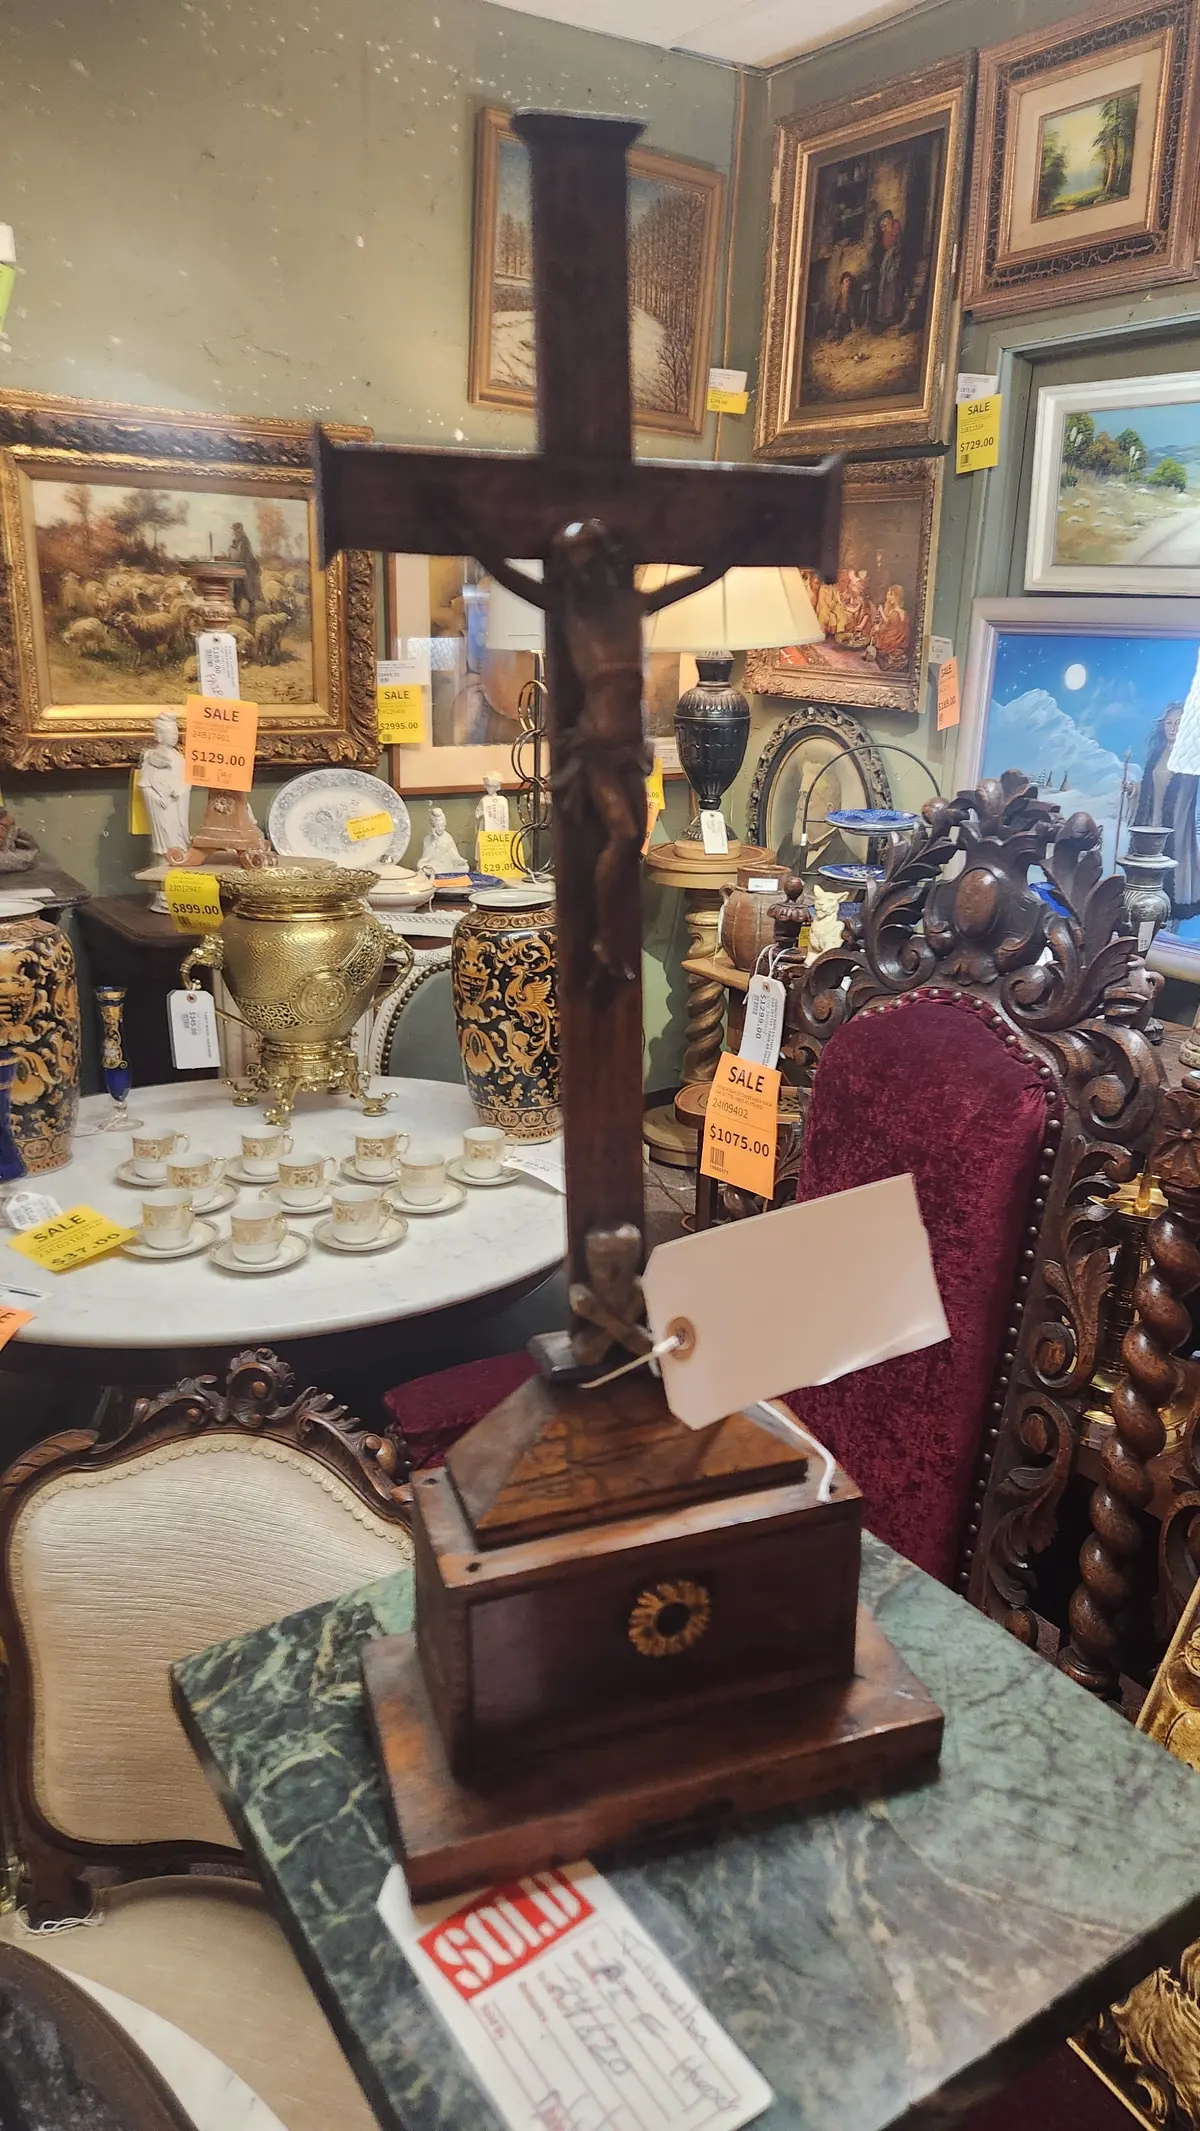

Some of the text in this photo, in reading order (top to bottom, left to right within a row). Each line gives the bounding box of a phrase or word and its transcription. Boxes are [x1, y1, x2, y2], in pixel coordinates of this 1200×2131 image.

[967, 402, 990, 415] SALE
[960, 437, 993, 452] $729.00
[941, 664, 952, 677] SALE
[384, 691, 410, 700] SALE
[204, 707, 239, 722] SALE
[380, 722, 418, 730] $2995.00
[191, 750, 245, 767] $129.00
[487, 834, 510, 842] SALE
[484, 864, 516, 873] $29.00
[172, 901, 219, 915] $899.00
[756, 995, 767, 1040] $1299.00
[728, 1066, 765, 1093] SALE
[709, 1124, 770, 1157] $1075.00
[34, 1214, 86, 1242] SALE
[52, 1233, 120, 1265] $37.00
[434, 1872, 582, 1989] SOLD
